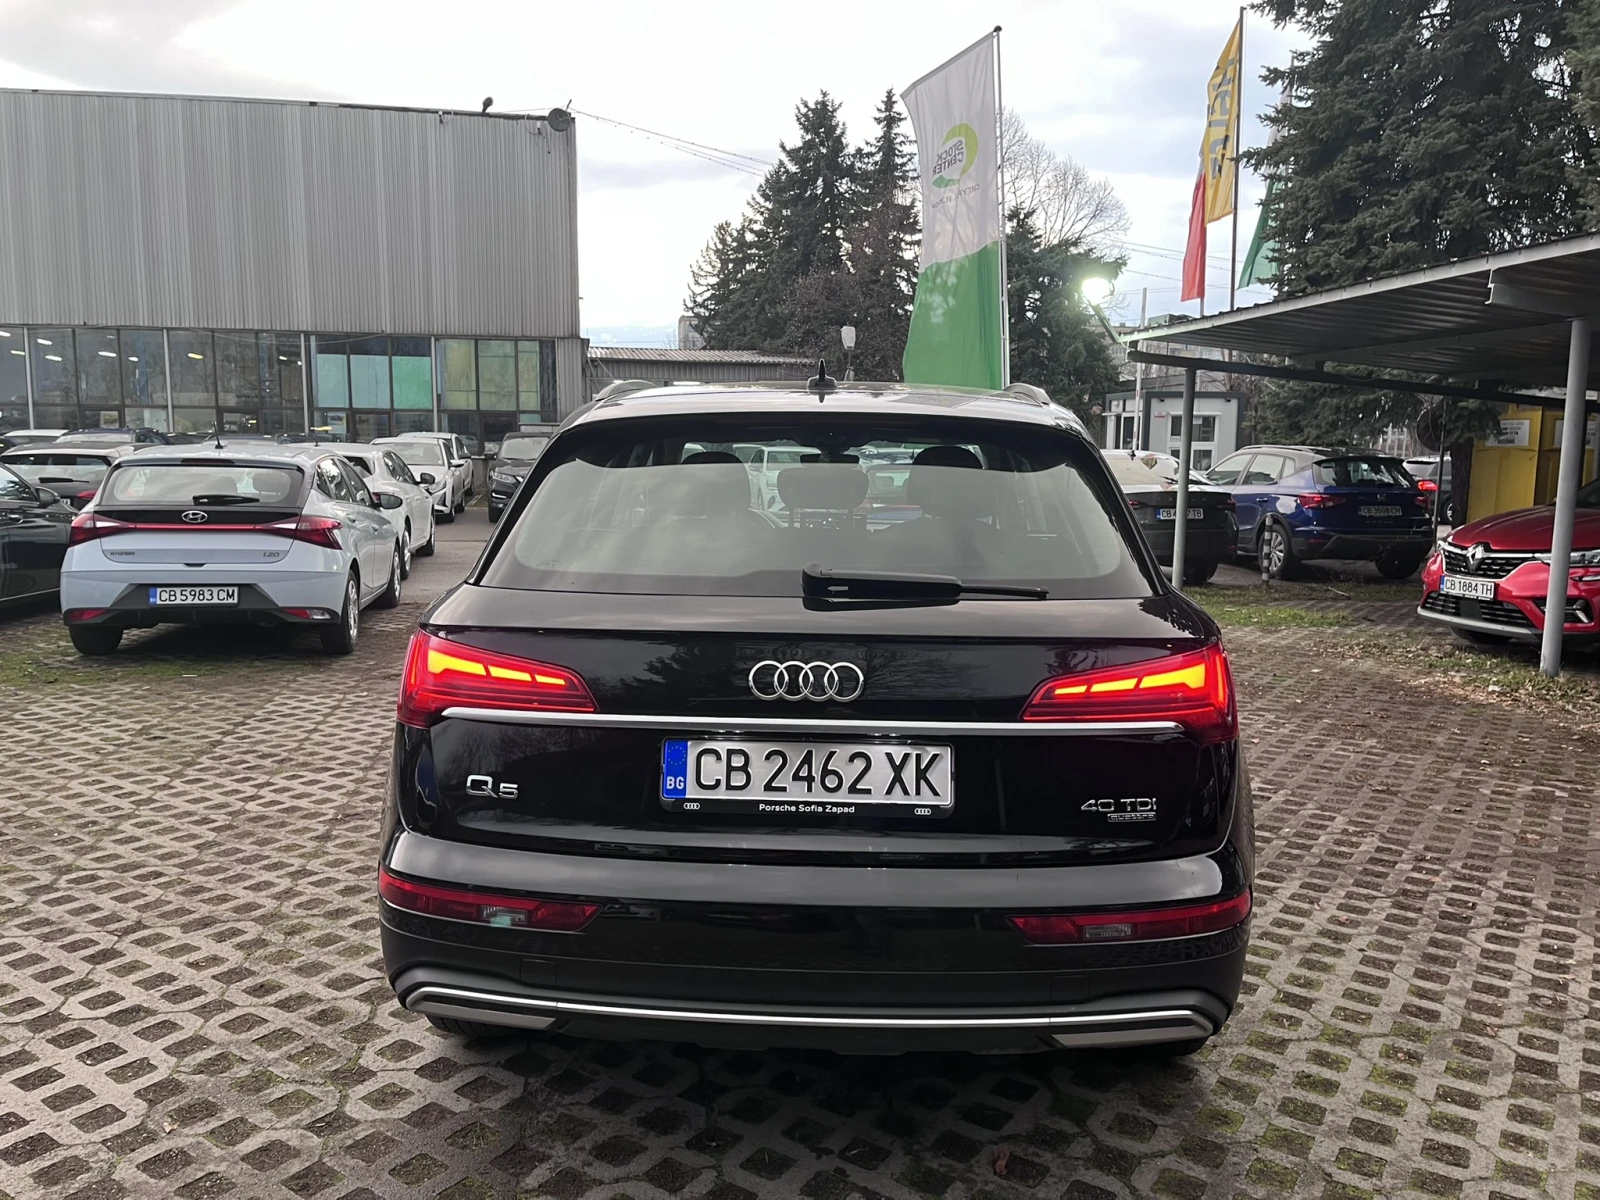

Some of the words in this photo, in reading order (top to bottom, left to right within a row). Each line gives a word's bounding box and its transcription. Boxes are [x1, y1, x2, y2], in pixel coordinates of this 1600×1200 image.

[1161, 509, 1172, 518] CB
[1191, 509, 1202, 518] TB
[1445, 579, 1456, 591] CB
[1458, 581, 1479, 594] 1884
[1480, 583, 1493, 596] TH
[159, 589, 177, 602] CB
[179, 589, 214, 602] 5983
[216, 588, 235, 602] CM
[695, 747, 751, 791] CB
[762, 748, 873, 795] 2462
[883, 751, 942, 797] XK
[466, 774, 519, 799] Q5
[666, 776, 685, 790] BG
[759, 803, 797, 813] Porsche
[798, 803, 823, 813] Sofia
[825, 804, 855, 815] Zapad
[1081, 799, 1115, 811] 40
[1120, 798, 1156, 811] TDI
